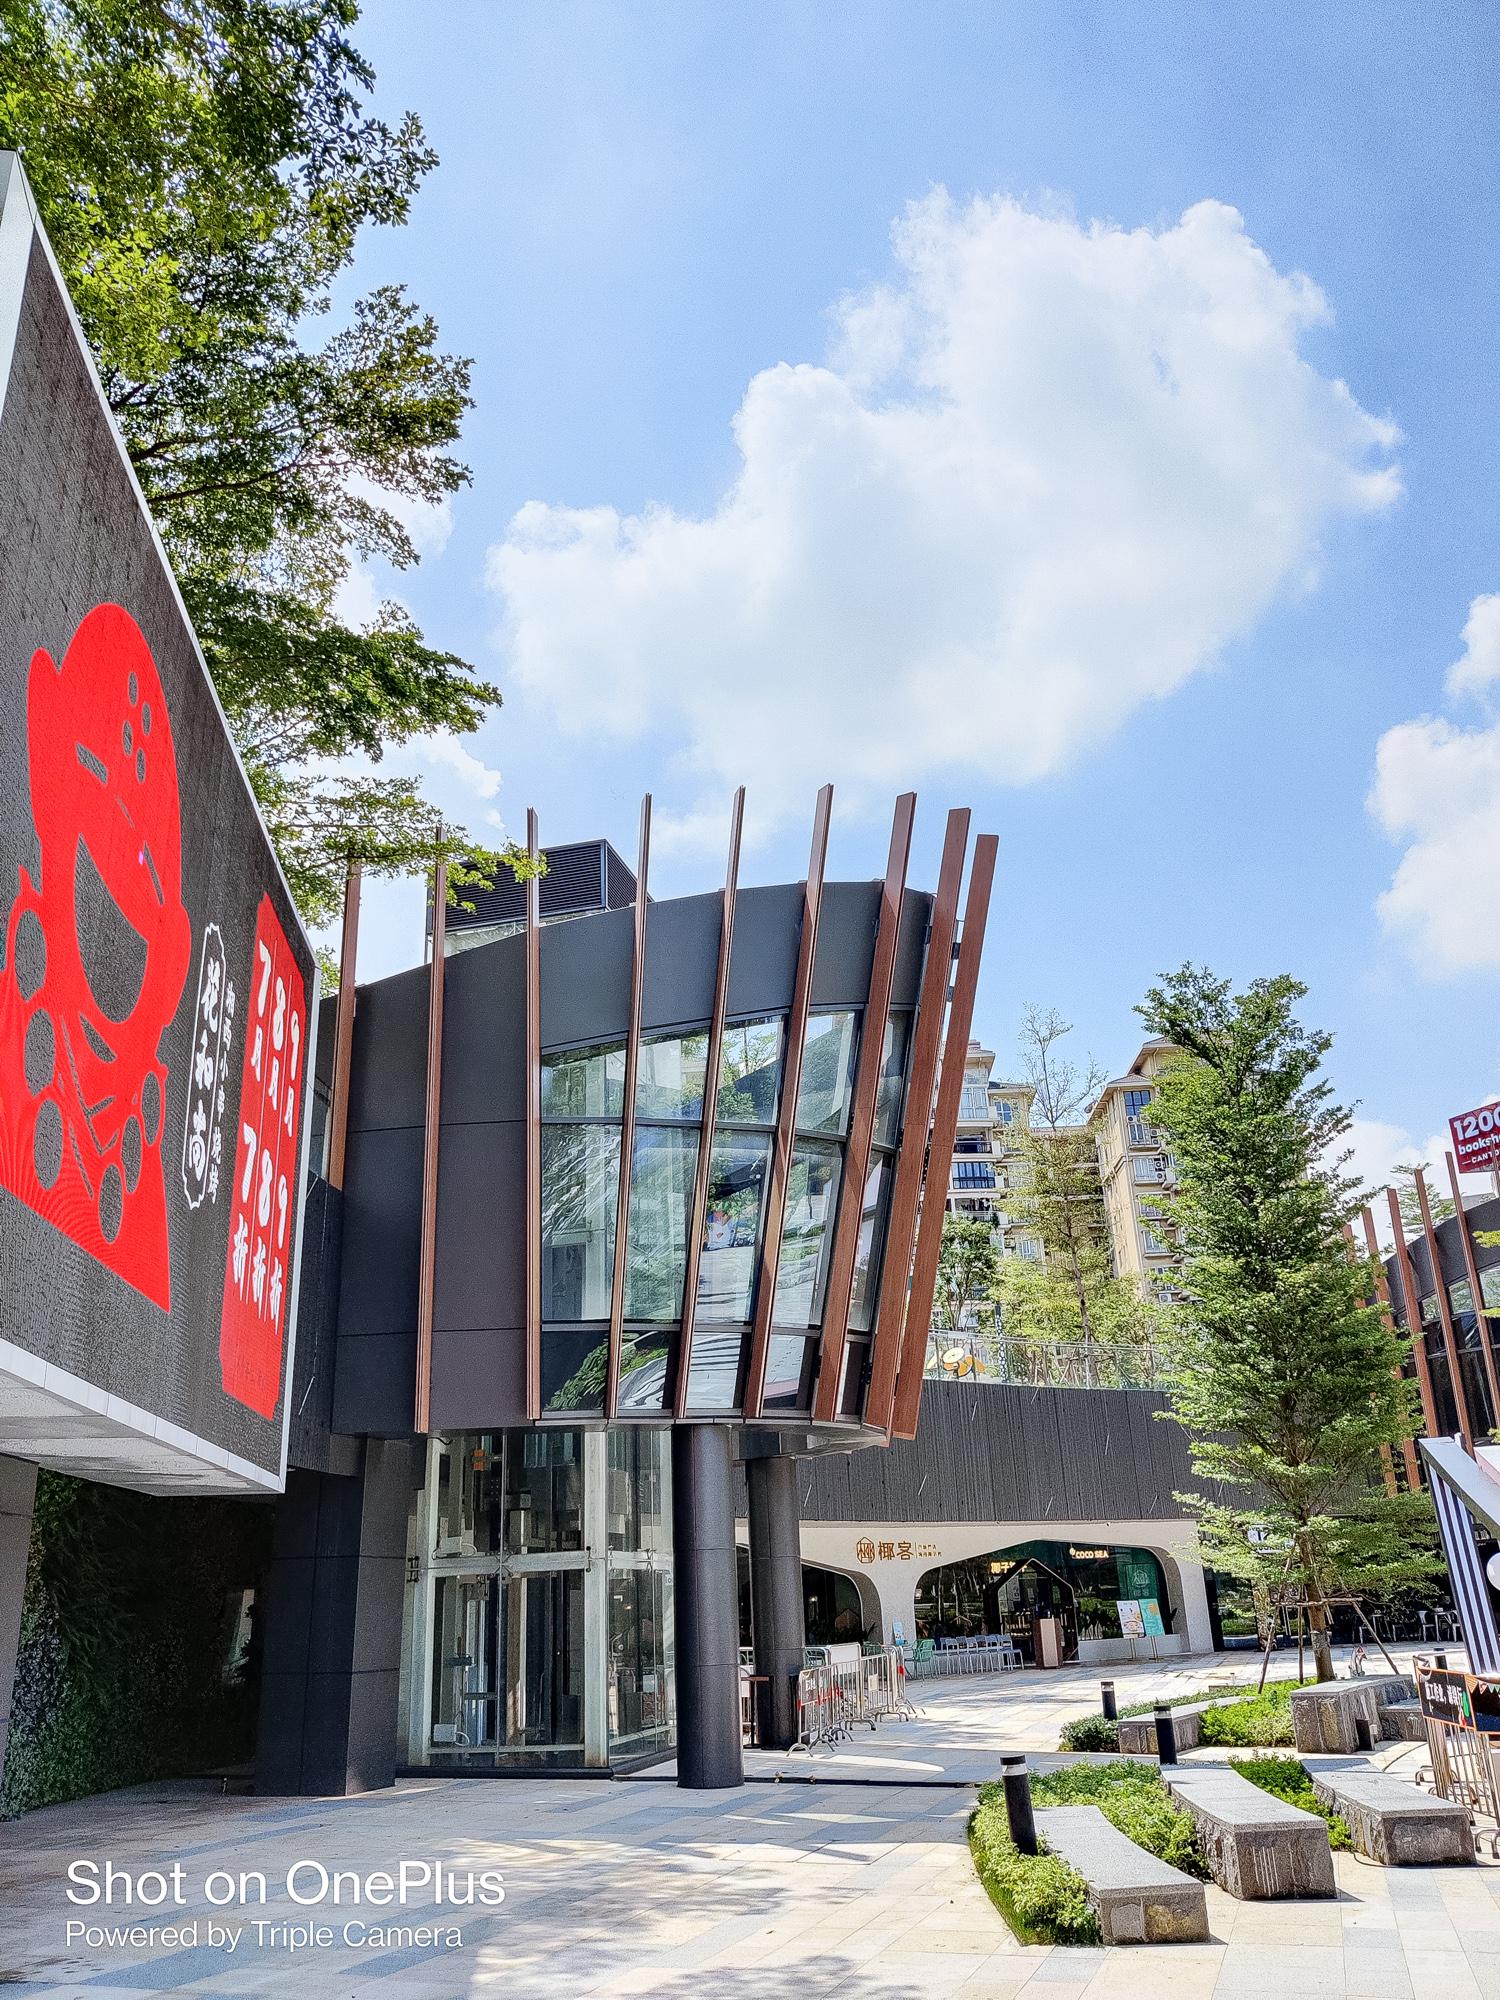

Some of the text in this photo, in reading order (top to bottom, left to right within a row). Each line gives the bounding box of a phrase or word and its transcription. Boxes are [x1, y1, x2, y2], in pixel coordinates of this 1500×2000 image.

[207, 980, 237, 1205] 湘西小串烧烤
[1458, 1133, 1500, 1155] booksh
[877, 1541, 914, 1561] 椰客
[1076, 1549, 1110, 1559] COCO SEA
